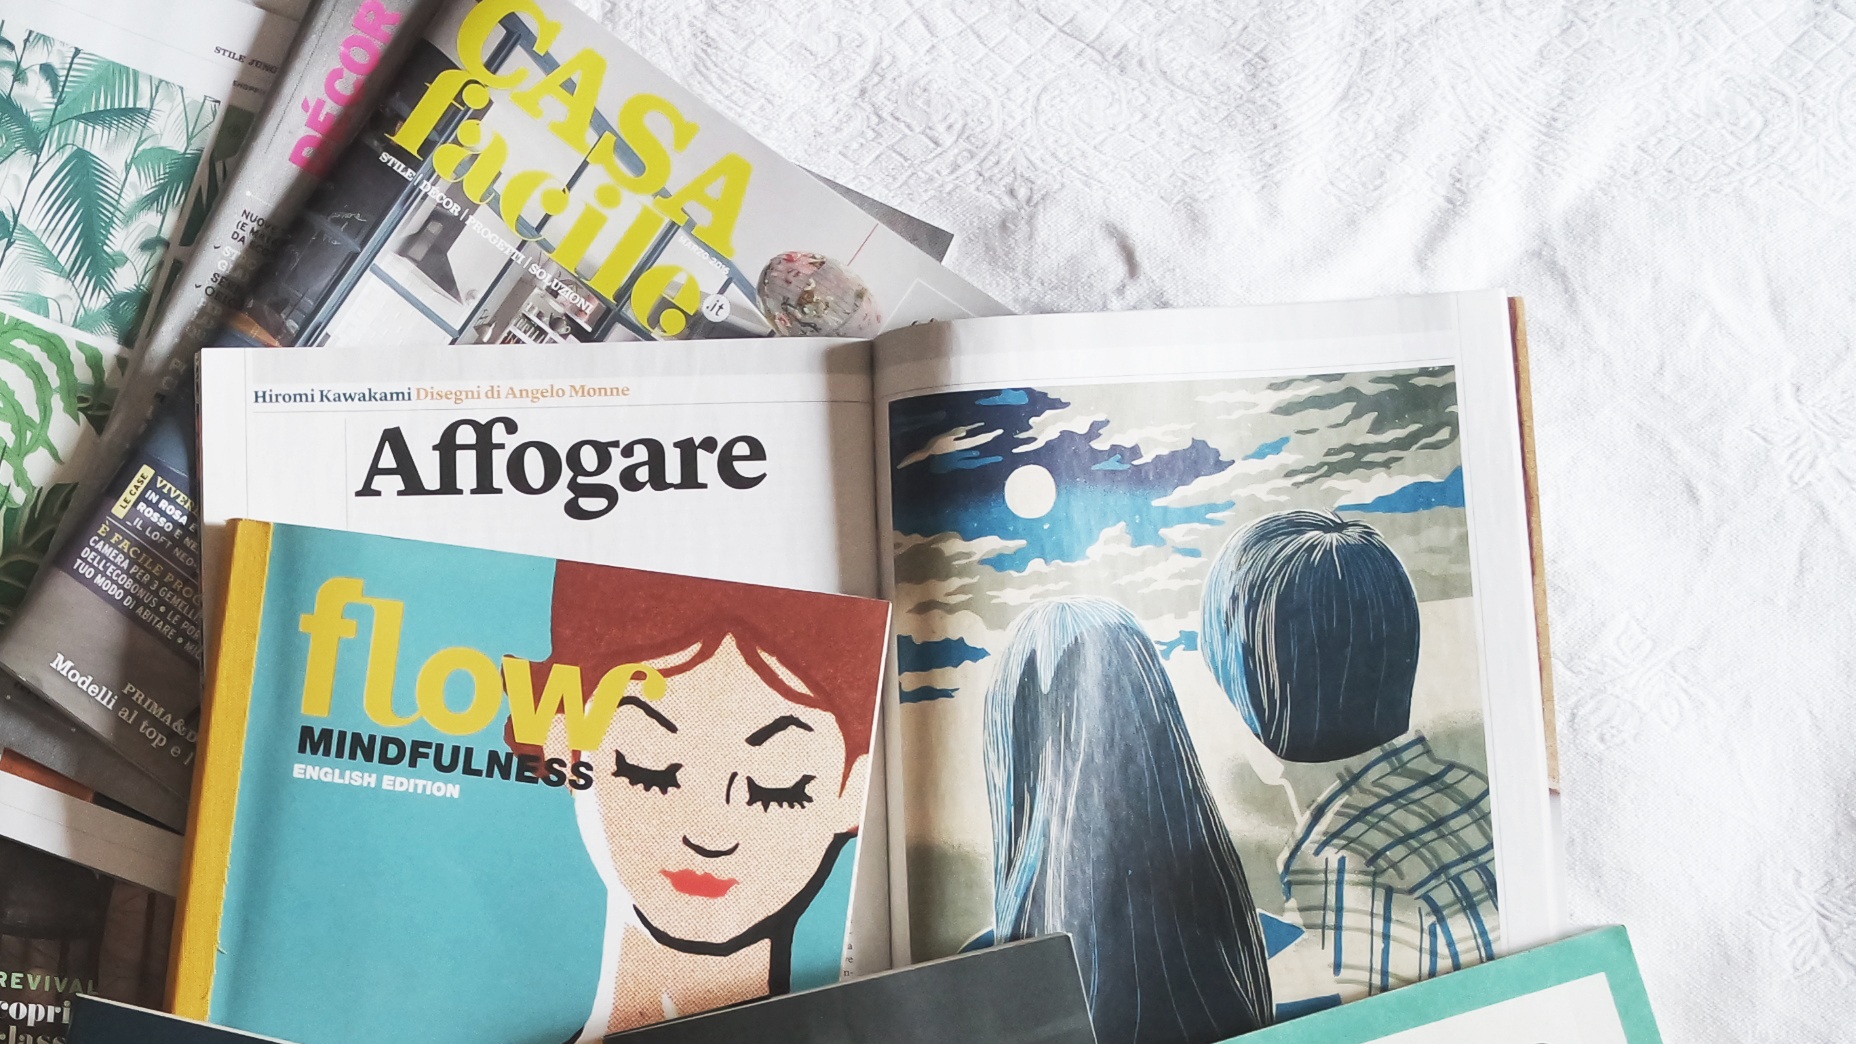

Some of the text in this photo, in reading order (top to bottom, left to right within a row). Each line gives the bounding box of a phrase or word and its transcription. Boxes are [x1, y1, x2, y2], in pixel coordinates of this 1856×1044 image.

[214, 46, 246, 62] STILE
[288, 0, 402, 177] DÉCOR
[457, 0, 753, 258] CASA
[385, 70, 702, 337] facile
[379, 152, 594, 314] STILE DÉCOR PROGETTI SOLUZIONI
[254, 384, 630, 404] Hiromi Kawakami Disegni di Angelo Monne
[120, 473, 148, 509] LE CASE
[355, 416, 768, 521] Affogare
[137, 502, 173, 531] ROSSO
[146, 526, 172, 548] LOFT
[159, 499, 187, 525] ROSA
[89, 536, 130, 570] CAMERA
[110, 532, 163, 576] FACILE
[73, 559, 176, 639] TUO MODO ABITARE
[299, 576, 666, 751] flow
[50, 652, 166, 748] Modelli top
[293, 763, 460, 799] ENGLISH EDITION
[297, 725, 593, 790] MINDFULNESS
